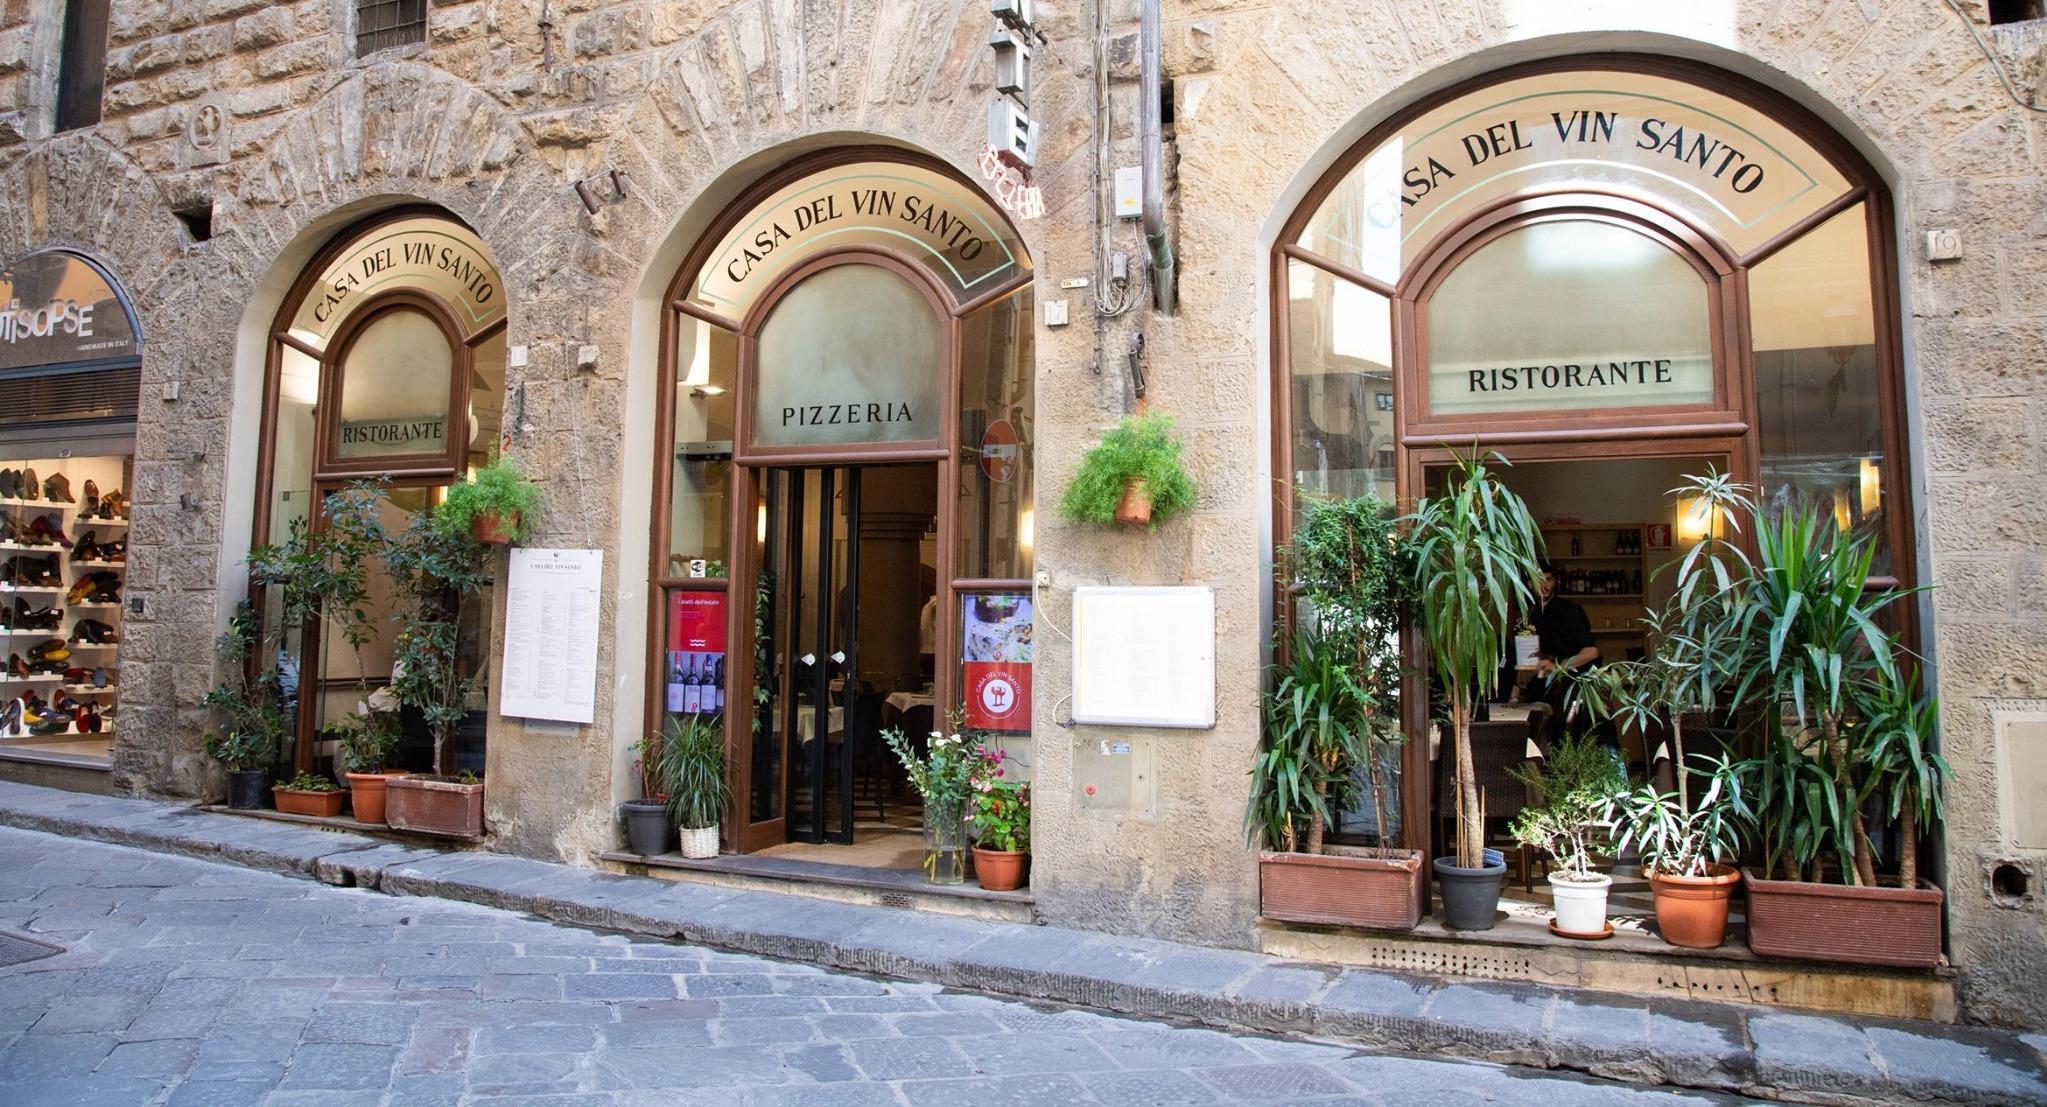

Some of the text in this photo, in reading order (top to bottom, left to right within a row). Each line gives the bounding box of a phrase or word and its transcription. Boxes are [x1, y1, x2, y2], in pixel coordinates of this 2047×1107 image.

[1461, 119, 1533, 167] DEL
[1550, 110, 1618, 143] VIN
[1636, 117, 1764, 194] SANTO
[727, 189, 984, 283] CASA DEL VIN SANTO
[314, 242, 493, 323] CASA DEL VIN SANTO
[114, 339, 129, 348] ITALY
[1468, 359, 1673, 393] RISTORANTE
[782, 401, 913, 427] PIZZERIA
[343, 422, 443, 444] RISTORANTE
